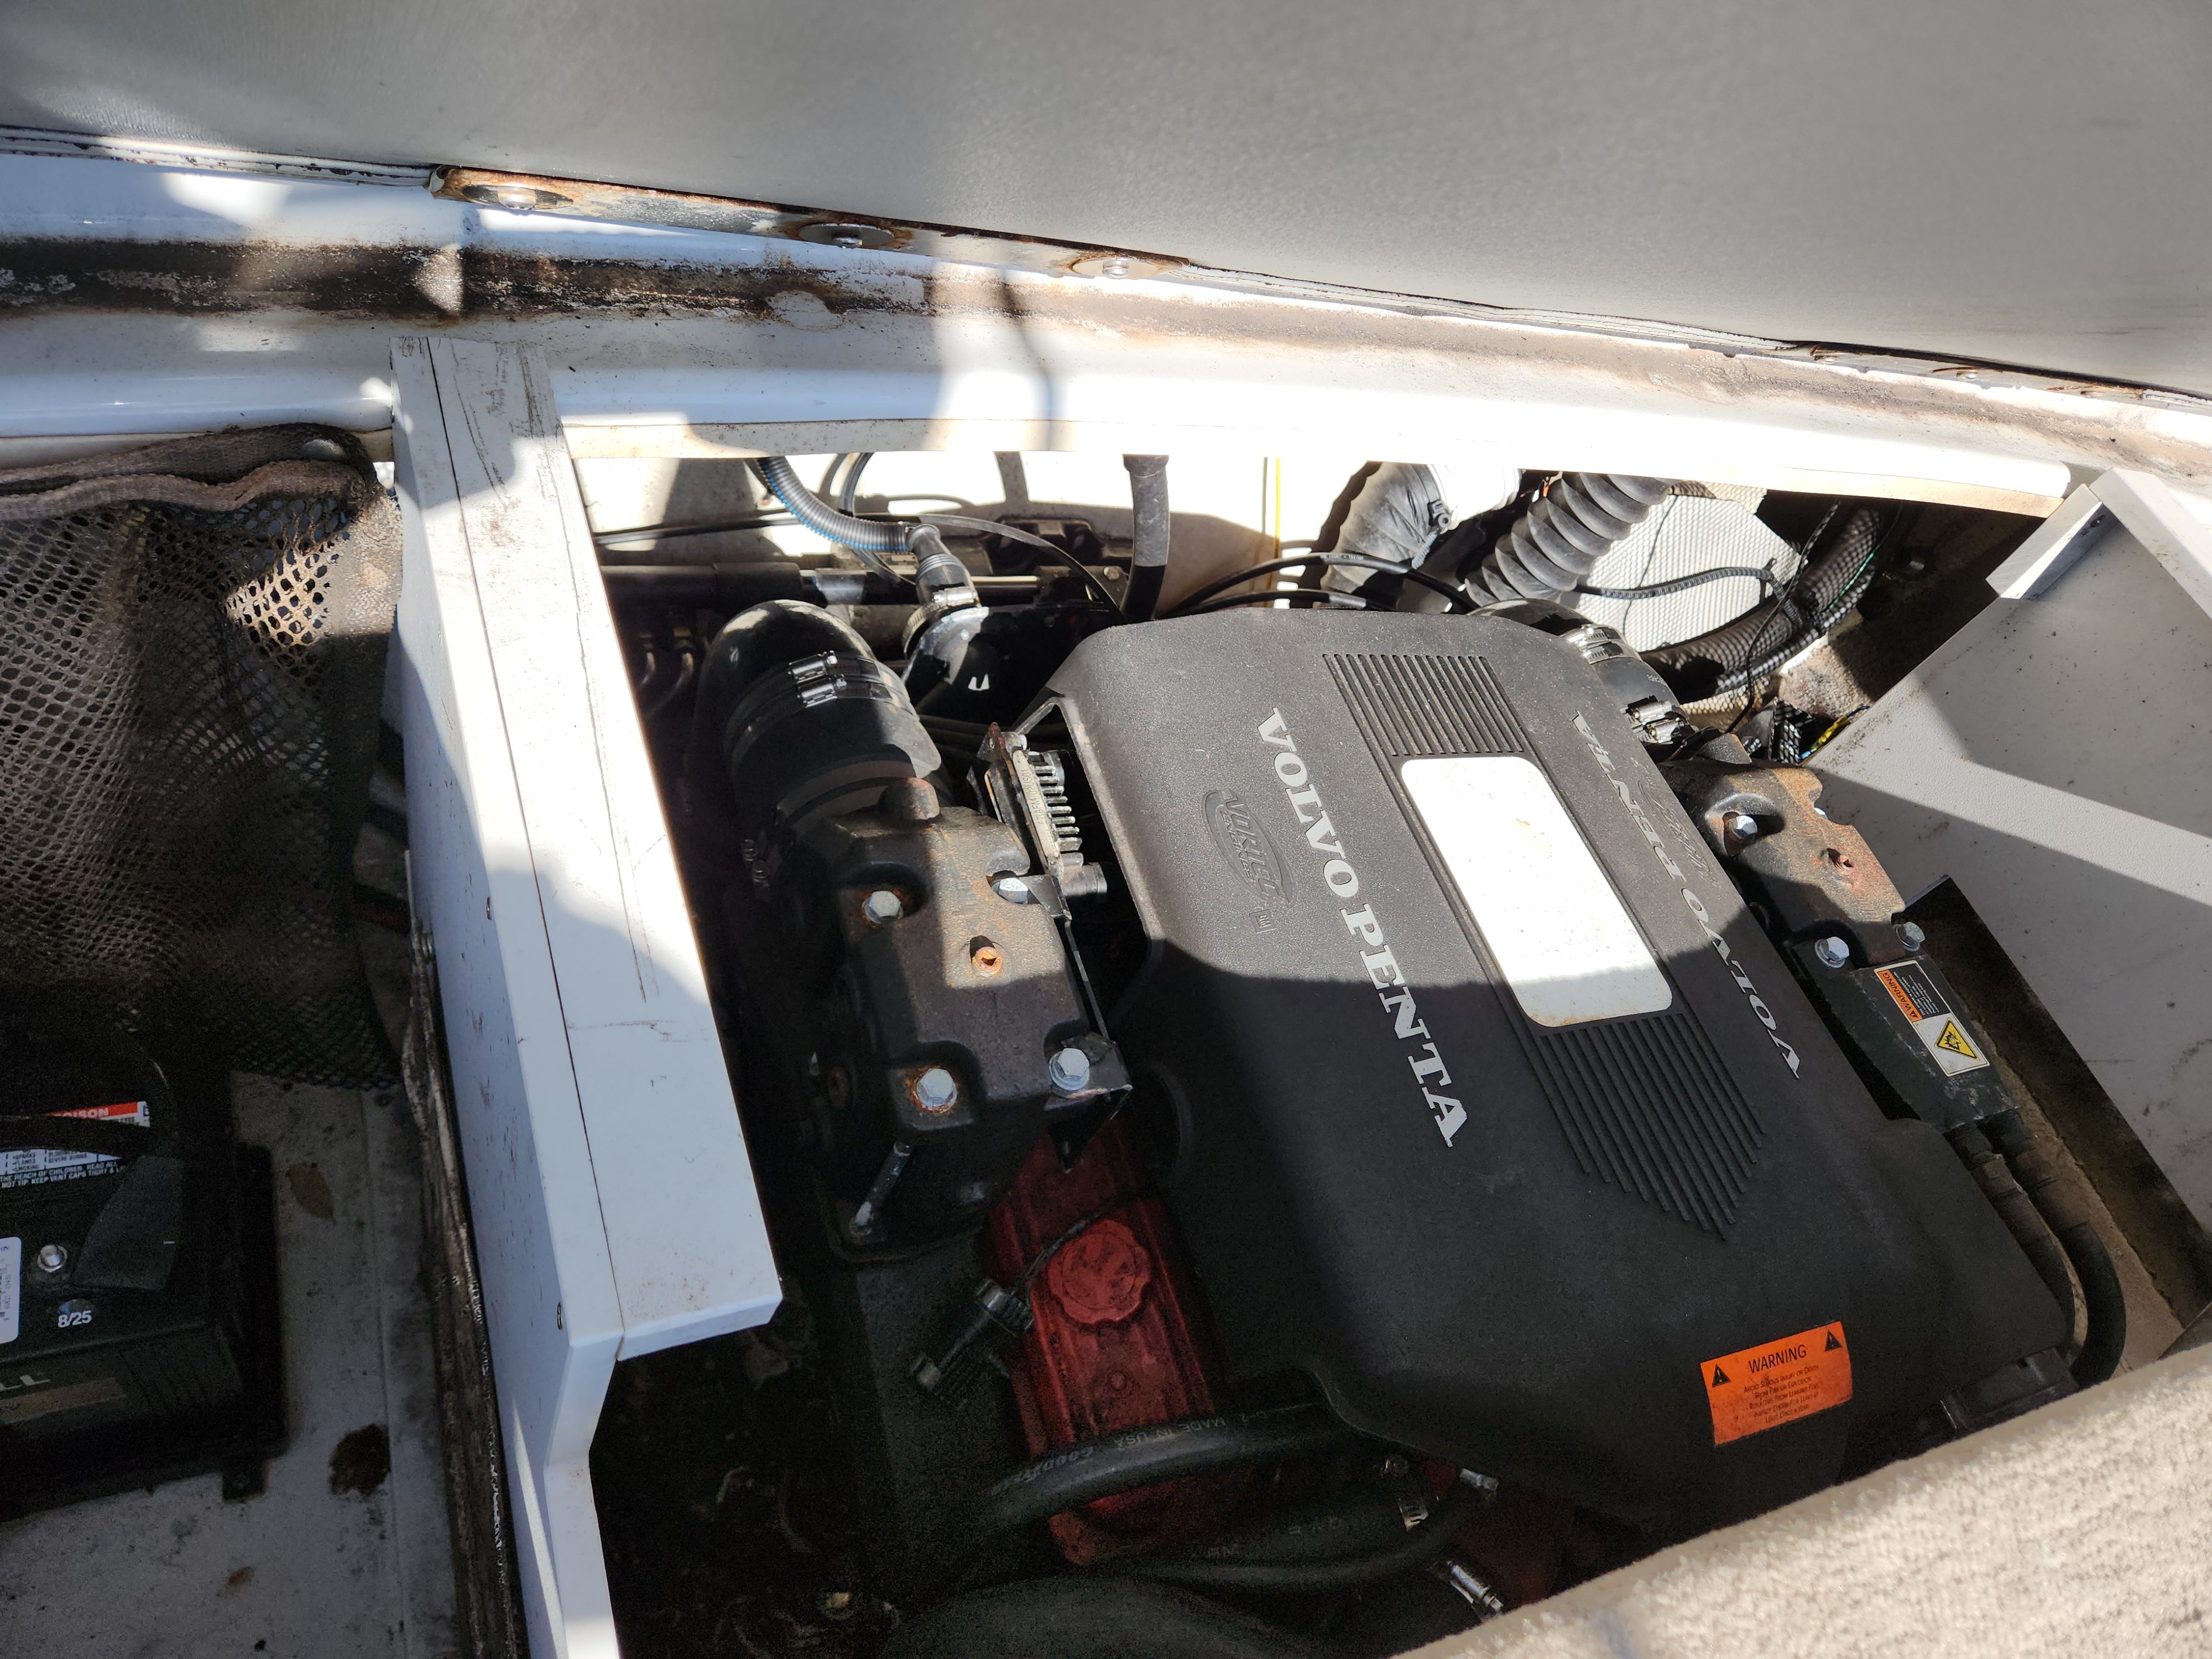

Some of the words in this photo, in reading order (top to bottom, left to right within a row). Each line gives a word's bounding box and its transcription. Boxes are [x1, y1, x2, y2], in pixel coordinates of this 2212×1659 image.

[1572, 710, 1686, 880] PENTA
[1257, 707, 1359, 897] VOLVO
[1339, 902, 1469, 1148] PENTA
[1681, 888, 1801, 1079] VOLVO
[1882, 973, 1912, 1011] WARNING
[57, 1310, 92, 1328] 8/25
[1749, 1344, 1807, 1373] WARNING
[1156, 1426, 1172, 1438] IN
[1178, 1416, 1227, 1433] MADE
[1114, 1432, 1147, 1451] USA
